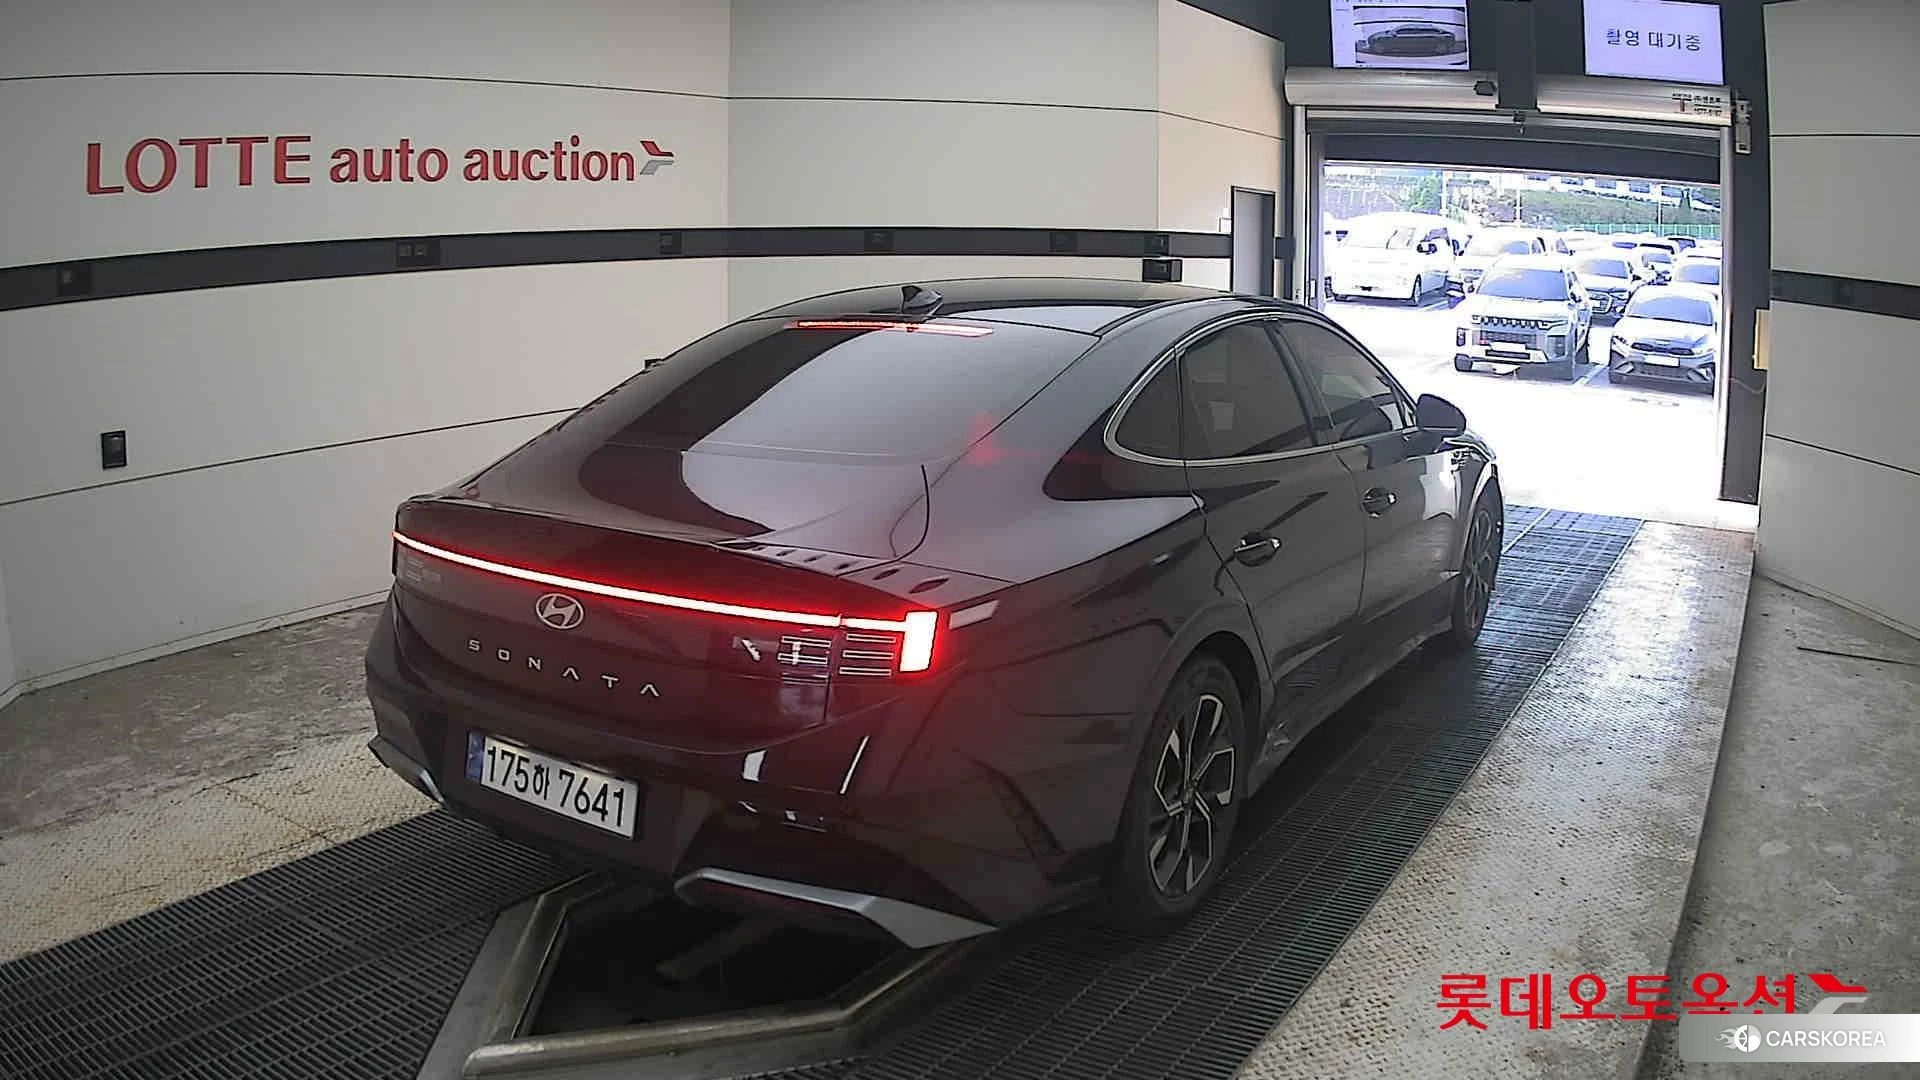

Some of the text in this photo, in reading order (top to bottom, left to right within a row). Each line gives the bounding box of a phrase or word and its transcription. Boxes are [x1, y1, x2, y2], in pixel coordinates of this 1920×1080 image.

[86, 134, 635, 195] LOTTE auto auction
[468, 639, 660, 697] SONATA
[487, 745, 625, 828] 175하 7641
